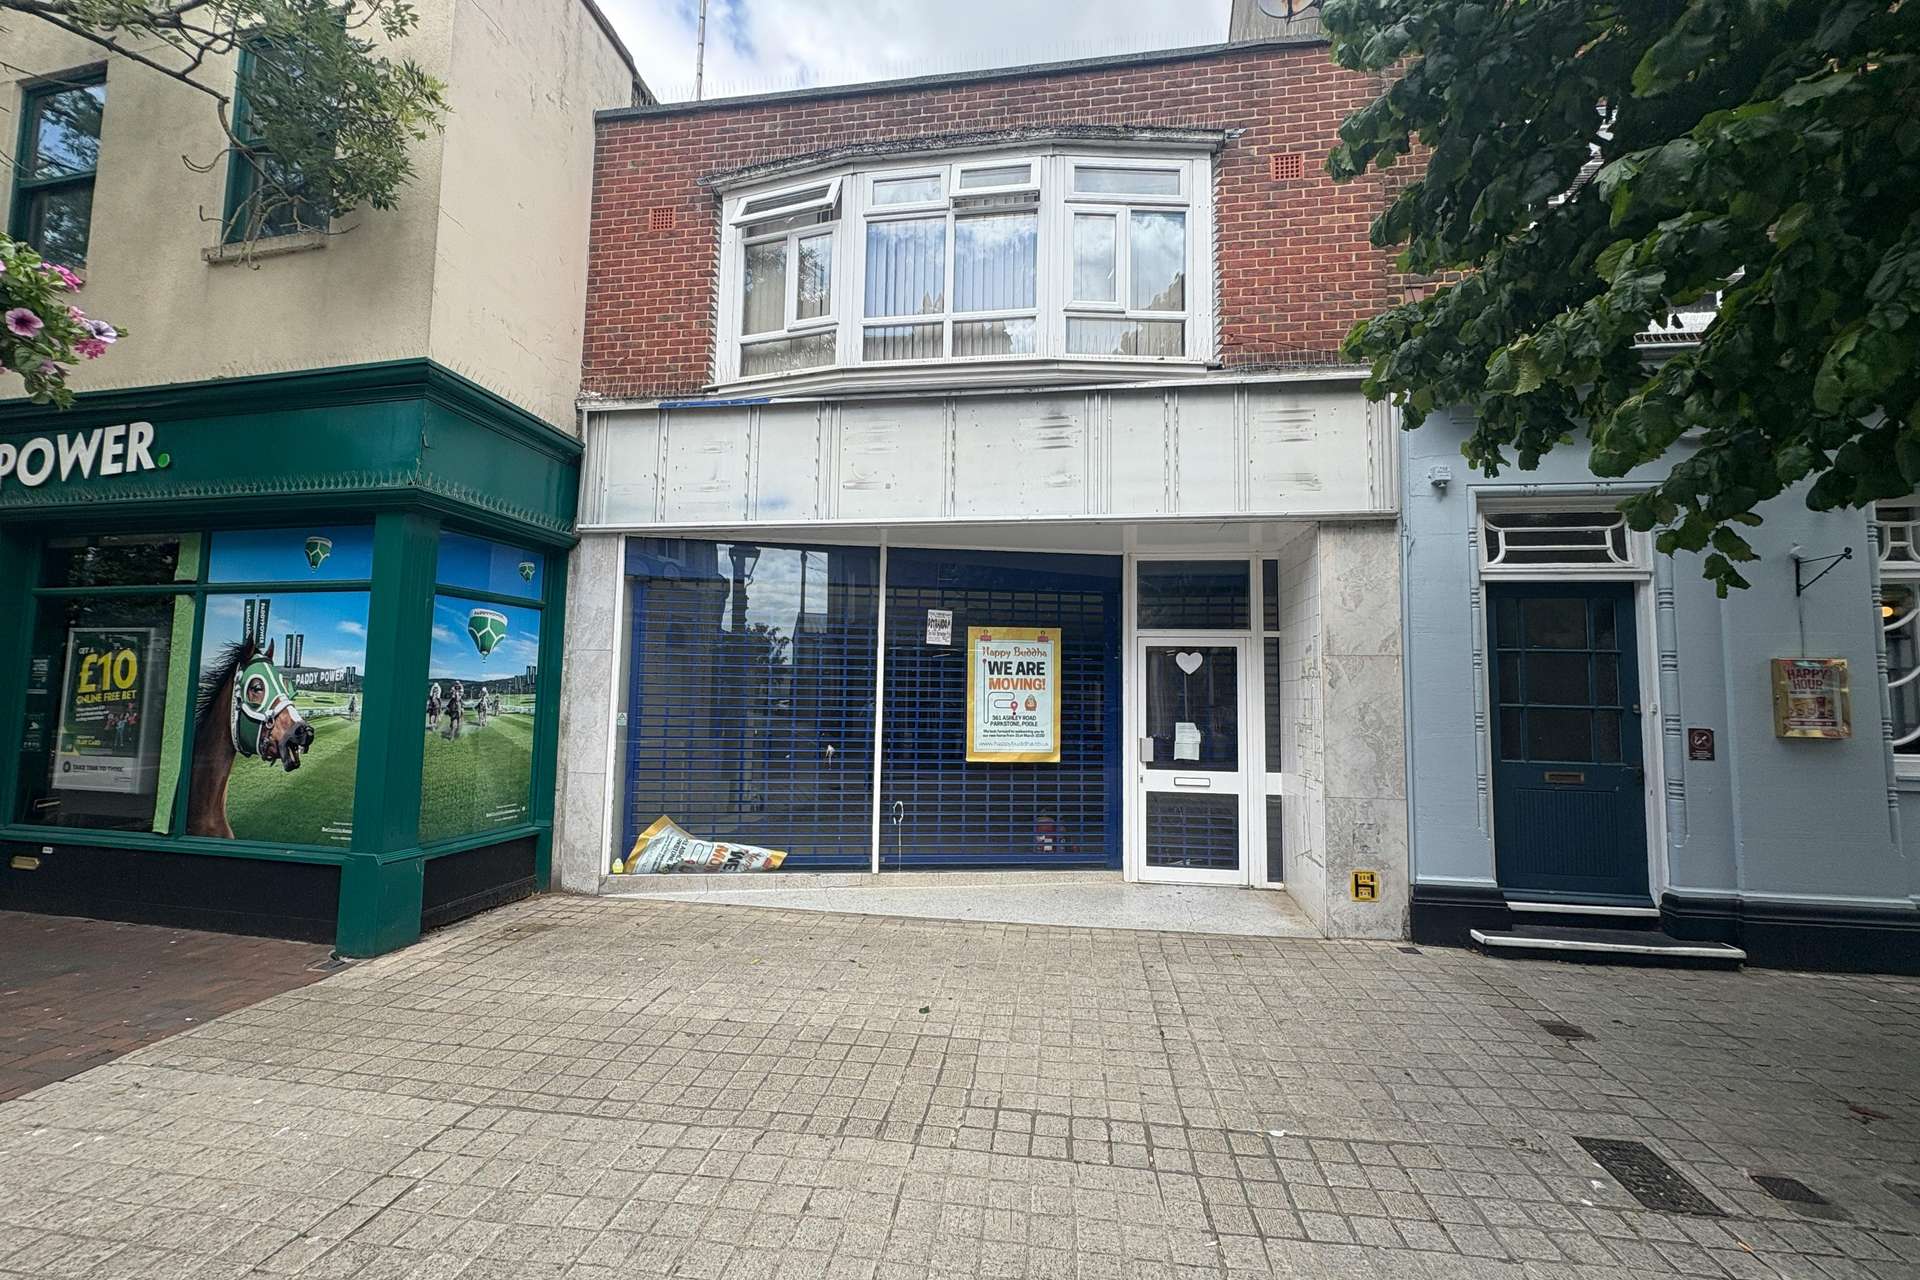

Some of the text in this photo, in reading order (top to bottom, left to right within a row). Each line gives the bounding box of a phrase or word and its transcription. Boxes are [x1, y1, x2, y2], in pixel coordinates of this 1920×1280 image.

[982, 646, 1047, 659] Happy Buddha
[77, 649, 138, 693] £10
[988, 661, 1045, 675] WE ARE
[1787, 668, 1828, 680] HAPPY
[296, 669, 344, 686] PADDY POWER
[988, 678, 1046, 690] MOVING!
[1792, 679, 1824, 690] HOUR
[103, 691, 121, 702] FREE
[121, 690, 137, 700] BET
